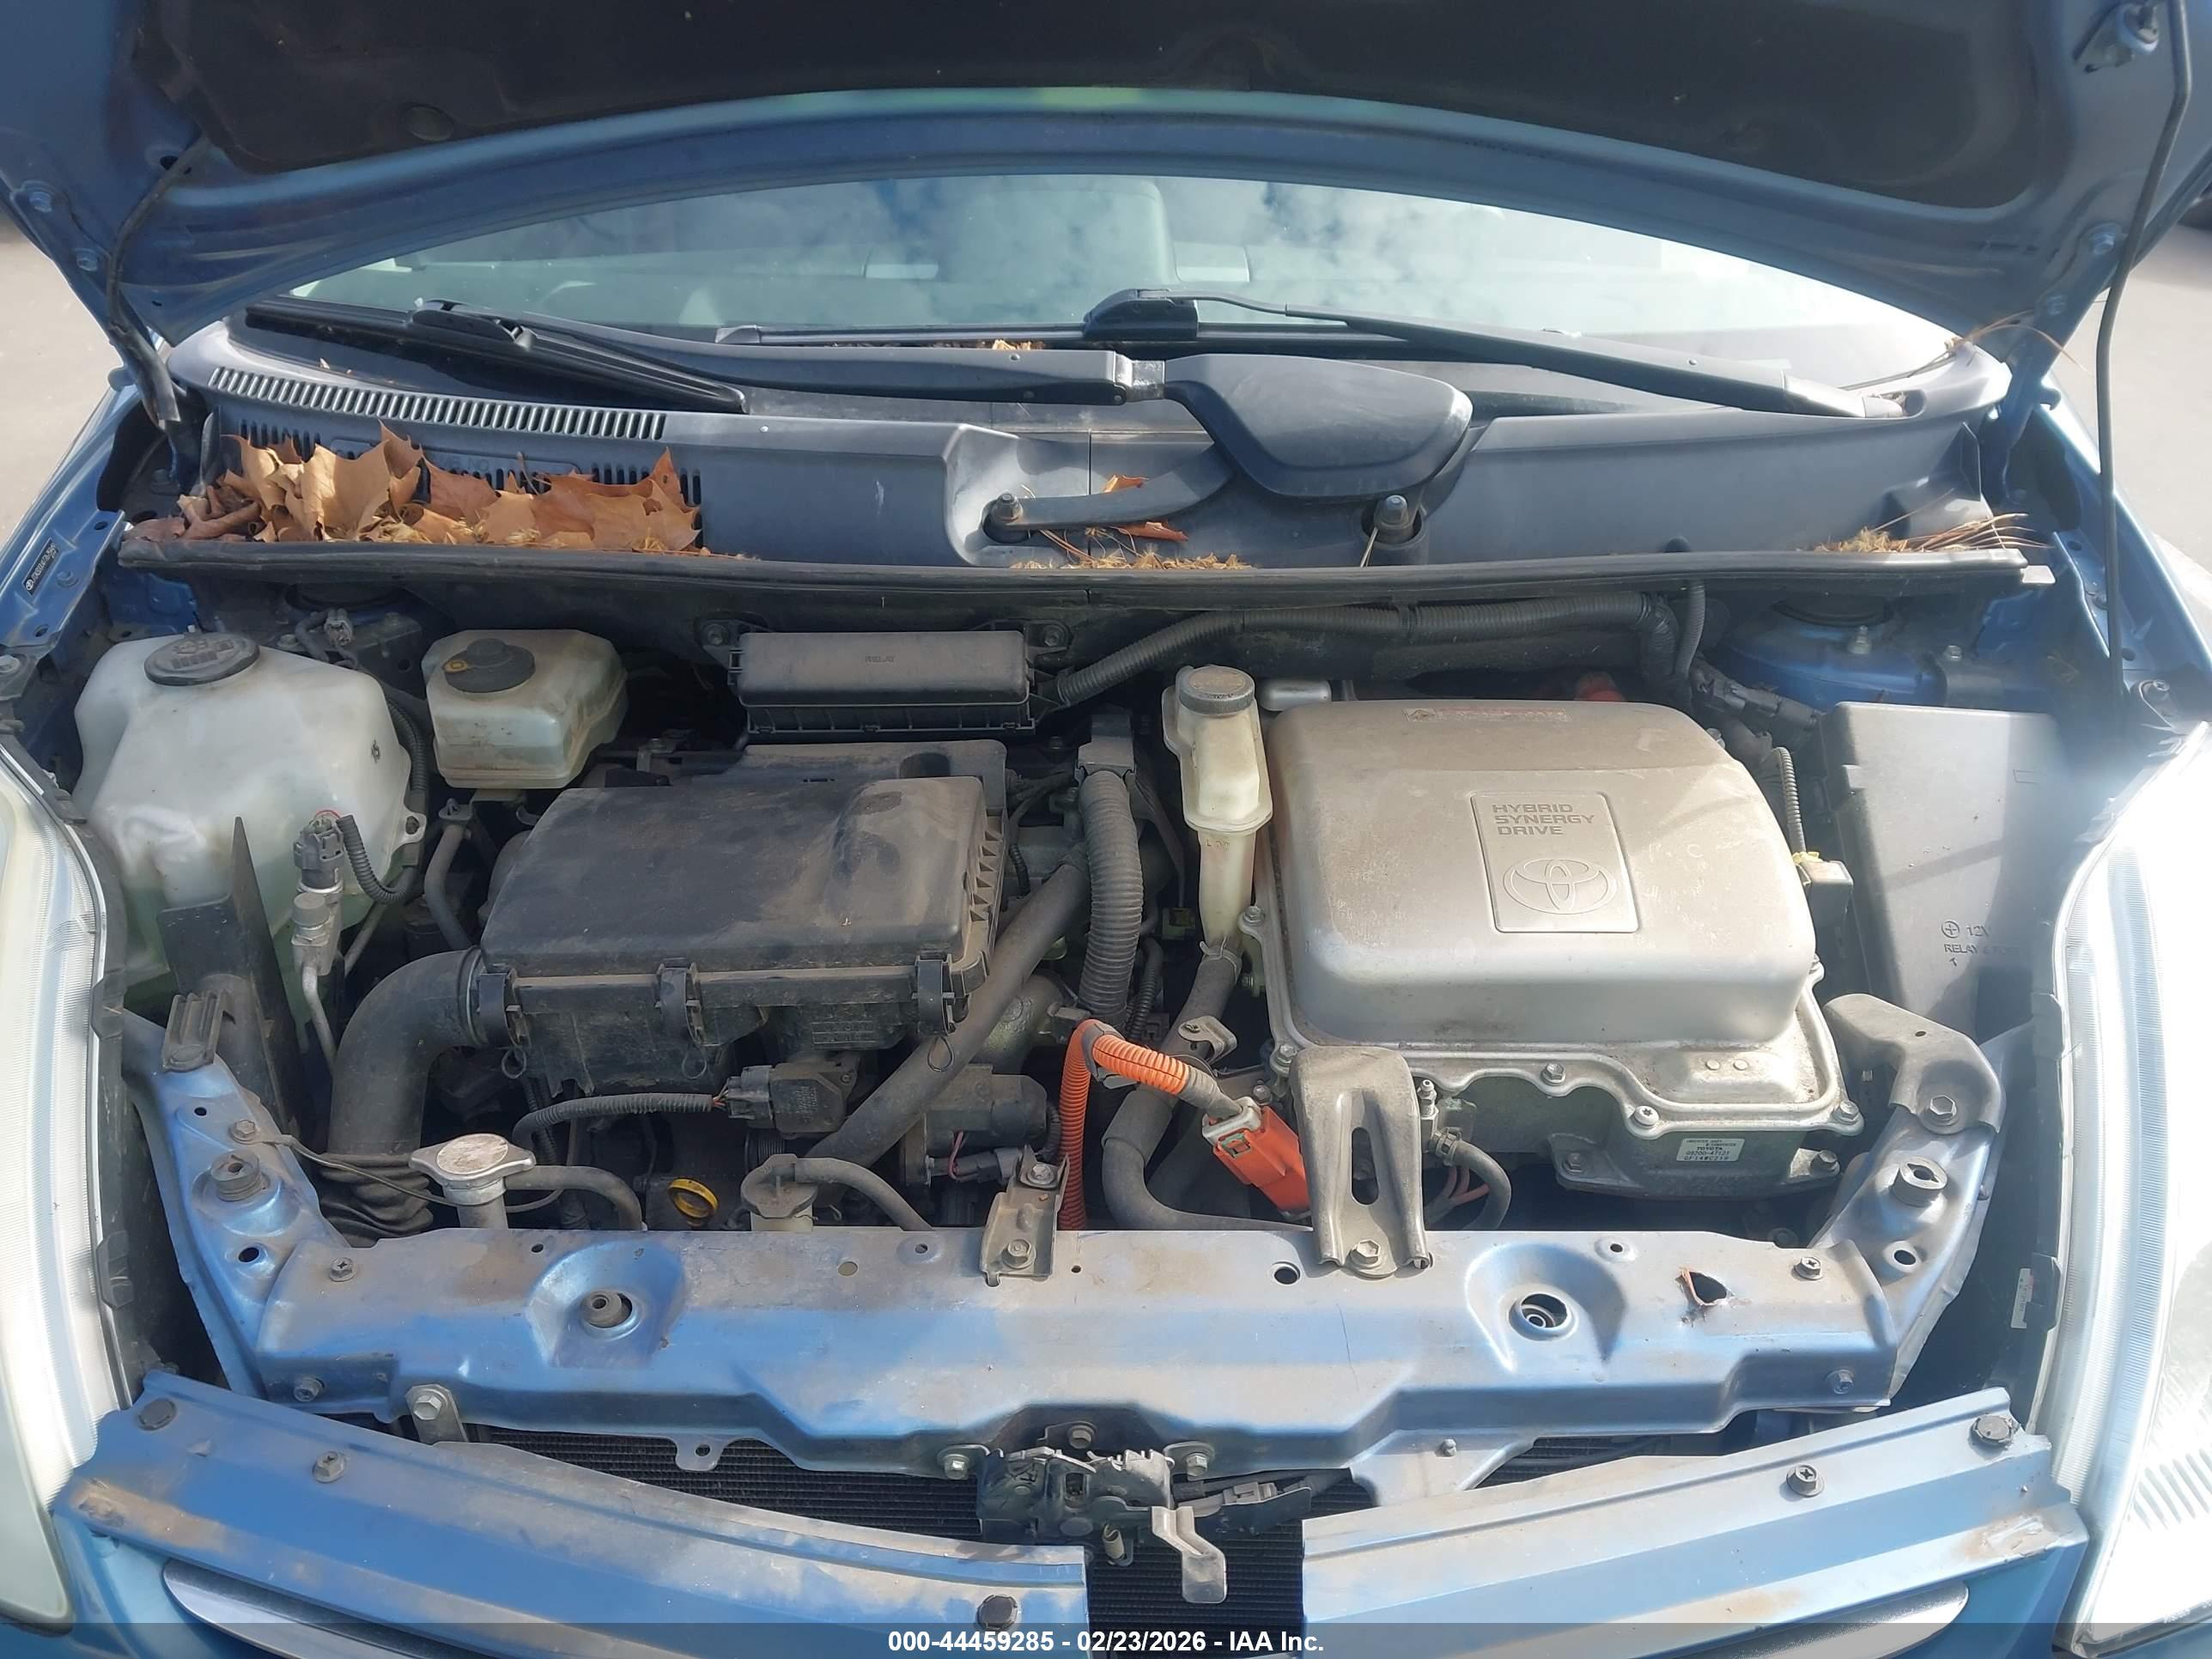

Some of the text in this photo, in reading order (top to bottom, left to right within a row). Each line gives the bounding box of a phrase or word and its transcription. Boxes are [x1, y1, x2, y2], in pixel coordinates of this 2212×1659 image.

[1492, 804, 1573, 812] HYBRID
[1496, 815, 1595, 823] SYNERGY
[1498, 825, 1564, 835] DRIVE
[1944, 944, 1978, 953] RELAY
